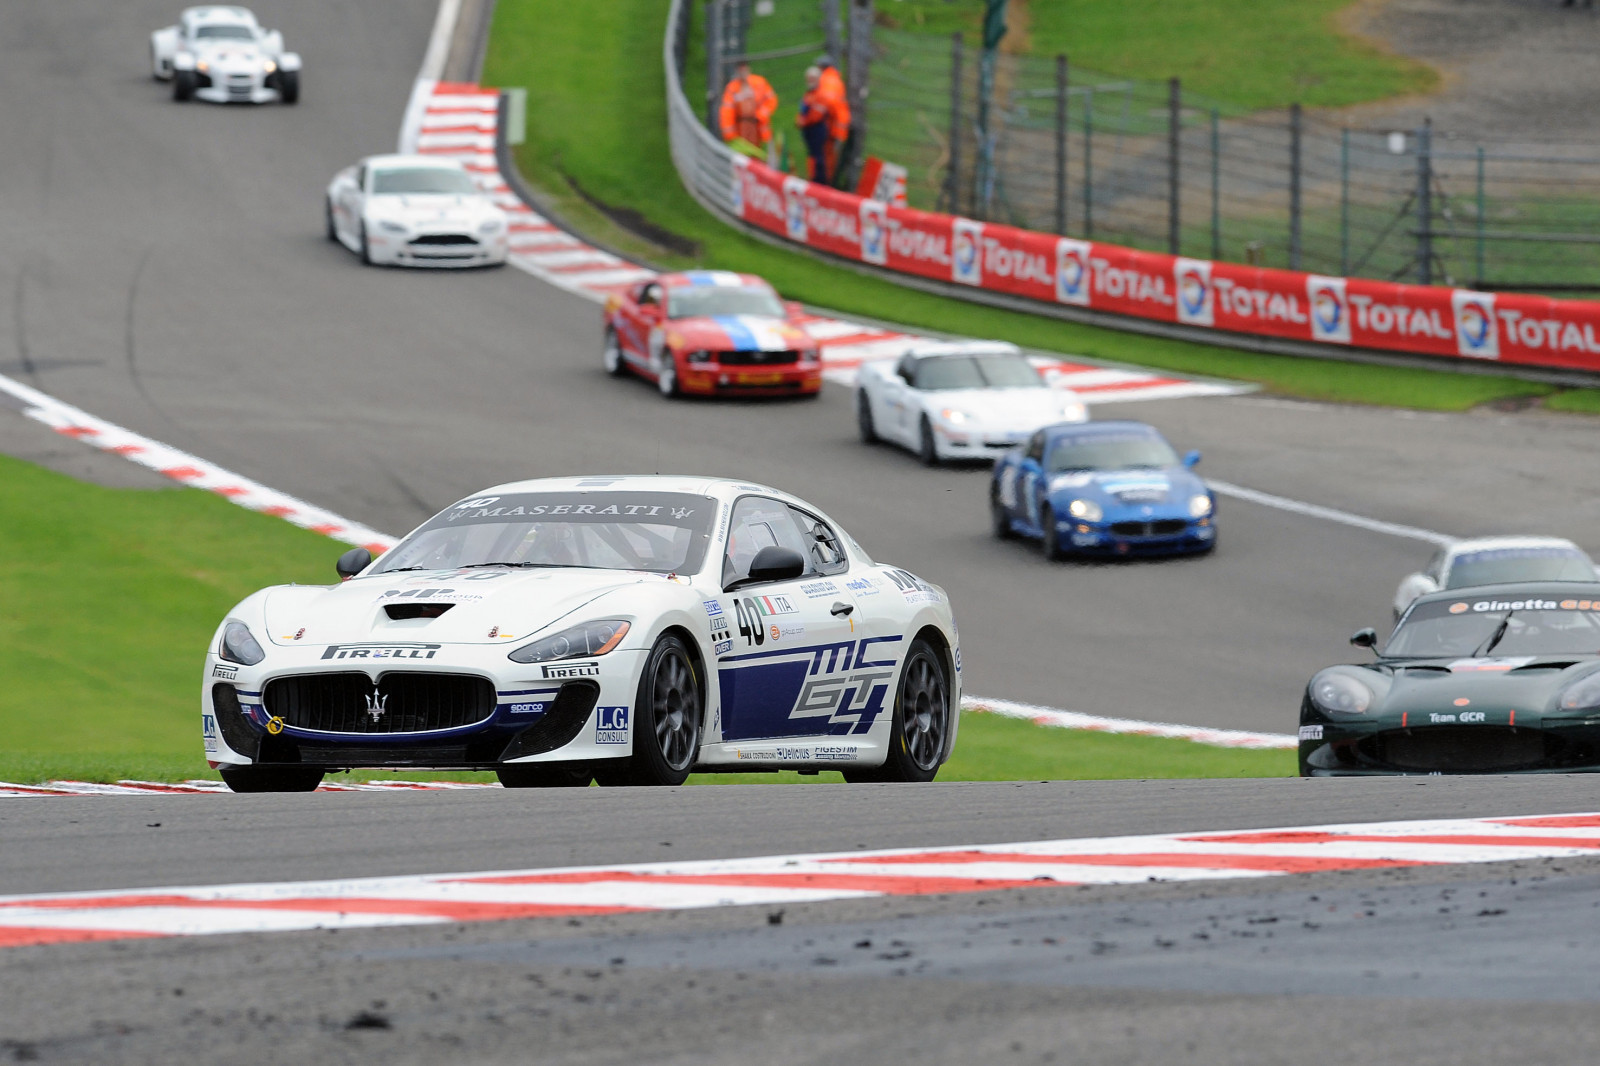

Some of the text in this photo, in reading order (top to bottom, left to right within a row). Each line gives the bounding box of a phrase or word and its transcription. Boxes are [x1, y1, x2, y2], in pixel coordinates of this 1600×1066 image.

[887, 218, 952, 266] TOTAL
[983, 237, 1054, 285] TOTAL
[1089, 257, 1174, 306] TOTAL
[1212, 277, 1308, 324] TOTAL
[1349, 294, 1453, 340] TOTAL
[469, 504, 665, 518] MASERATI
[774, 597, 794, 612] ITA
[1473, 599, 1557, 613] Ginetta
[733, 598, 765, 646] 40
[320, 643, 442, 660] PIRELLI
[212, 664, 239, 680] PIRELLI
[541, 662, 600, 679] PIRELLI
[510, 703, 544, 714] sparco
[1428, 711, 1485, 723] Team GCR
[597, 731, 628, 743] CONSULT
